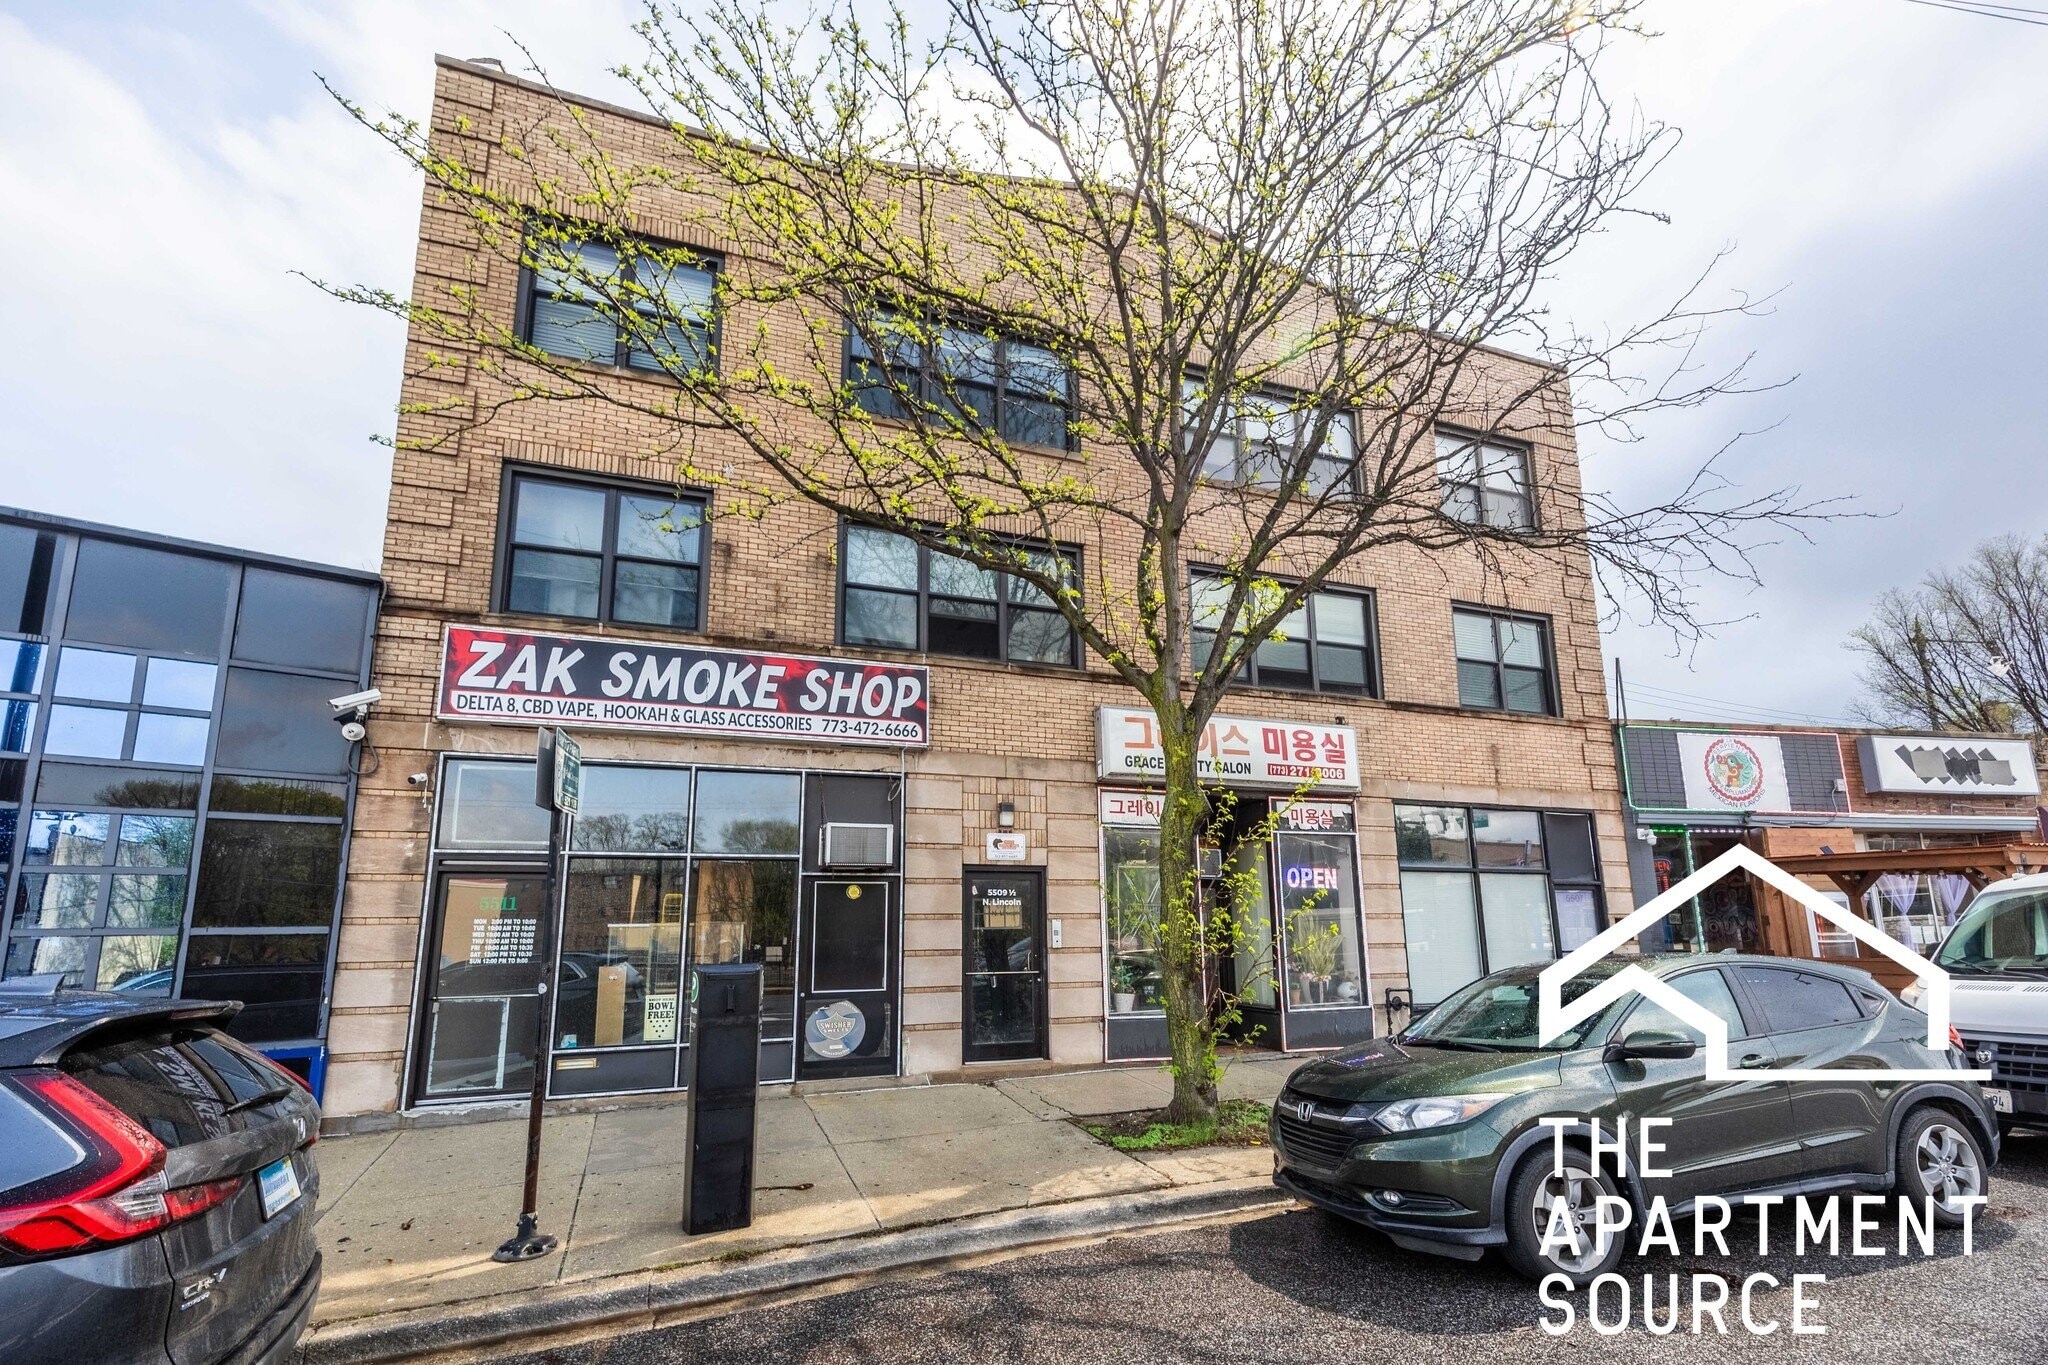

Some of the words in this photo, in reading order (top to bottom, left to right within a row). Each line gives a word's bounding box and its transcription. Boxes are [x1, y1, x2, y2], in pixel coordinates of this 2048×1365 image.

[457, 640, 585, 696] ZAK
[601, 651, 787, 710] SMOKE
[799, 668, 922, 718] SHOP
[456, 694, 503, 712] DELTA
[506, 697, 519, 715] 8,
[522, 698, 554, 715] CBD
[557, 700, 598, 720] VAPE,
[603, 703, 668, 723] HOOKAH
[670, 707, 680, 722] &
[683, 709, 726, 726] GLASS
[728, 712, 812, 731] ACCESSORIES
[821, 718, 919, 738] 773-472-6666
[1125, 716, 1250, 758] 그이스
[1262, 727, 1346, 764] 미용실
[1125, 755, 1164, 769] GRACE
[1270, 764, 1288, 775] (773)
[1290, 765, 1344, 778] 271006
[1708, 786, 1738, 808] MEXICAN
[1740, 788, 1766, 808] FLAVORS
[1290, 808, 1334, 826] 미용실
[1286, 866, 1338, 889] OPEN
[987, 888, 1008, 896] 5509
[480, 896, 517, 910] 5511
[982, 898, 991, 906] N.
[992, 898, 1022, 906] Lincoln
[648, 1002, 675, 1010] BOWL
[647, 1010, 675, 1020] FREE!
[183, 1267, 227, 1300] CR-V
